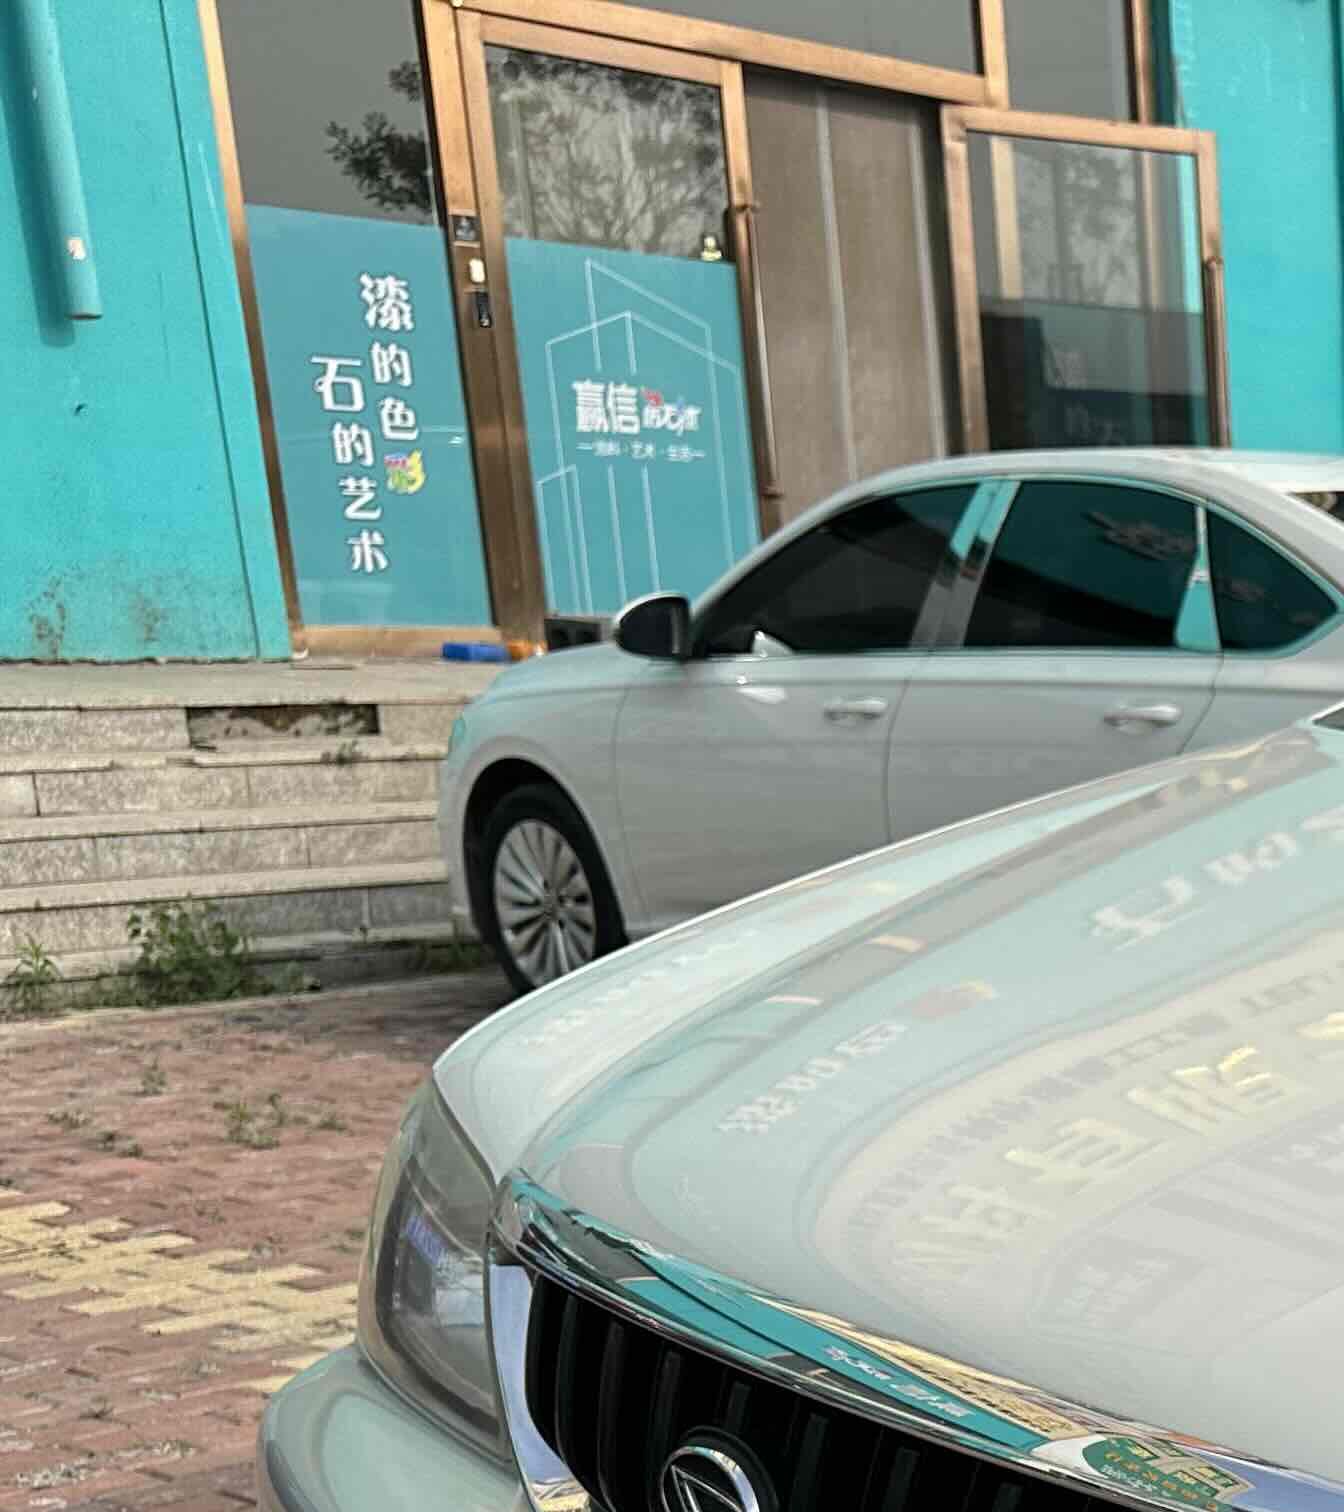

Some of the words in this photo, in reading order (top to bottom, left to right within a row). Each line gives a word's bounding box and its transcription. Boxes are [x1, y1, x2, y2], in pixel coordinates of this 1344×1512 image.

[309, 355, 389, 574] 石的艺术
[359, 272, 427, 496] 漆的色彩
